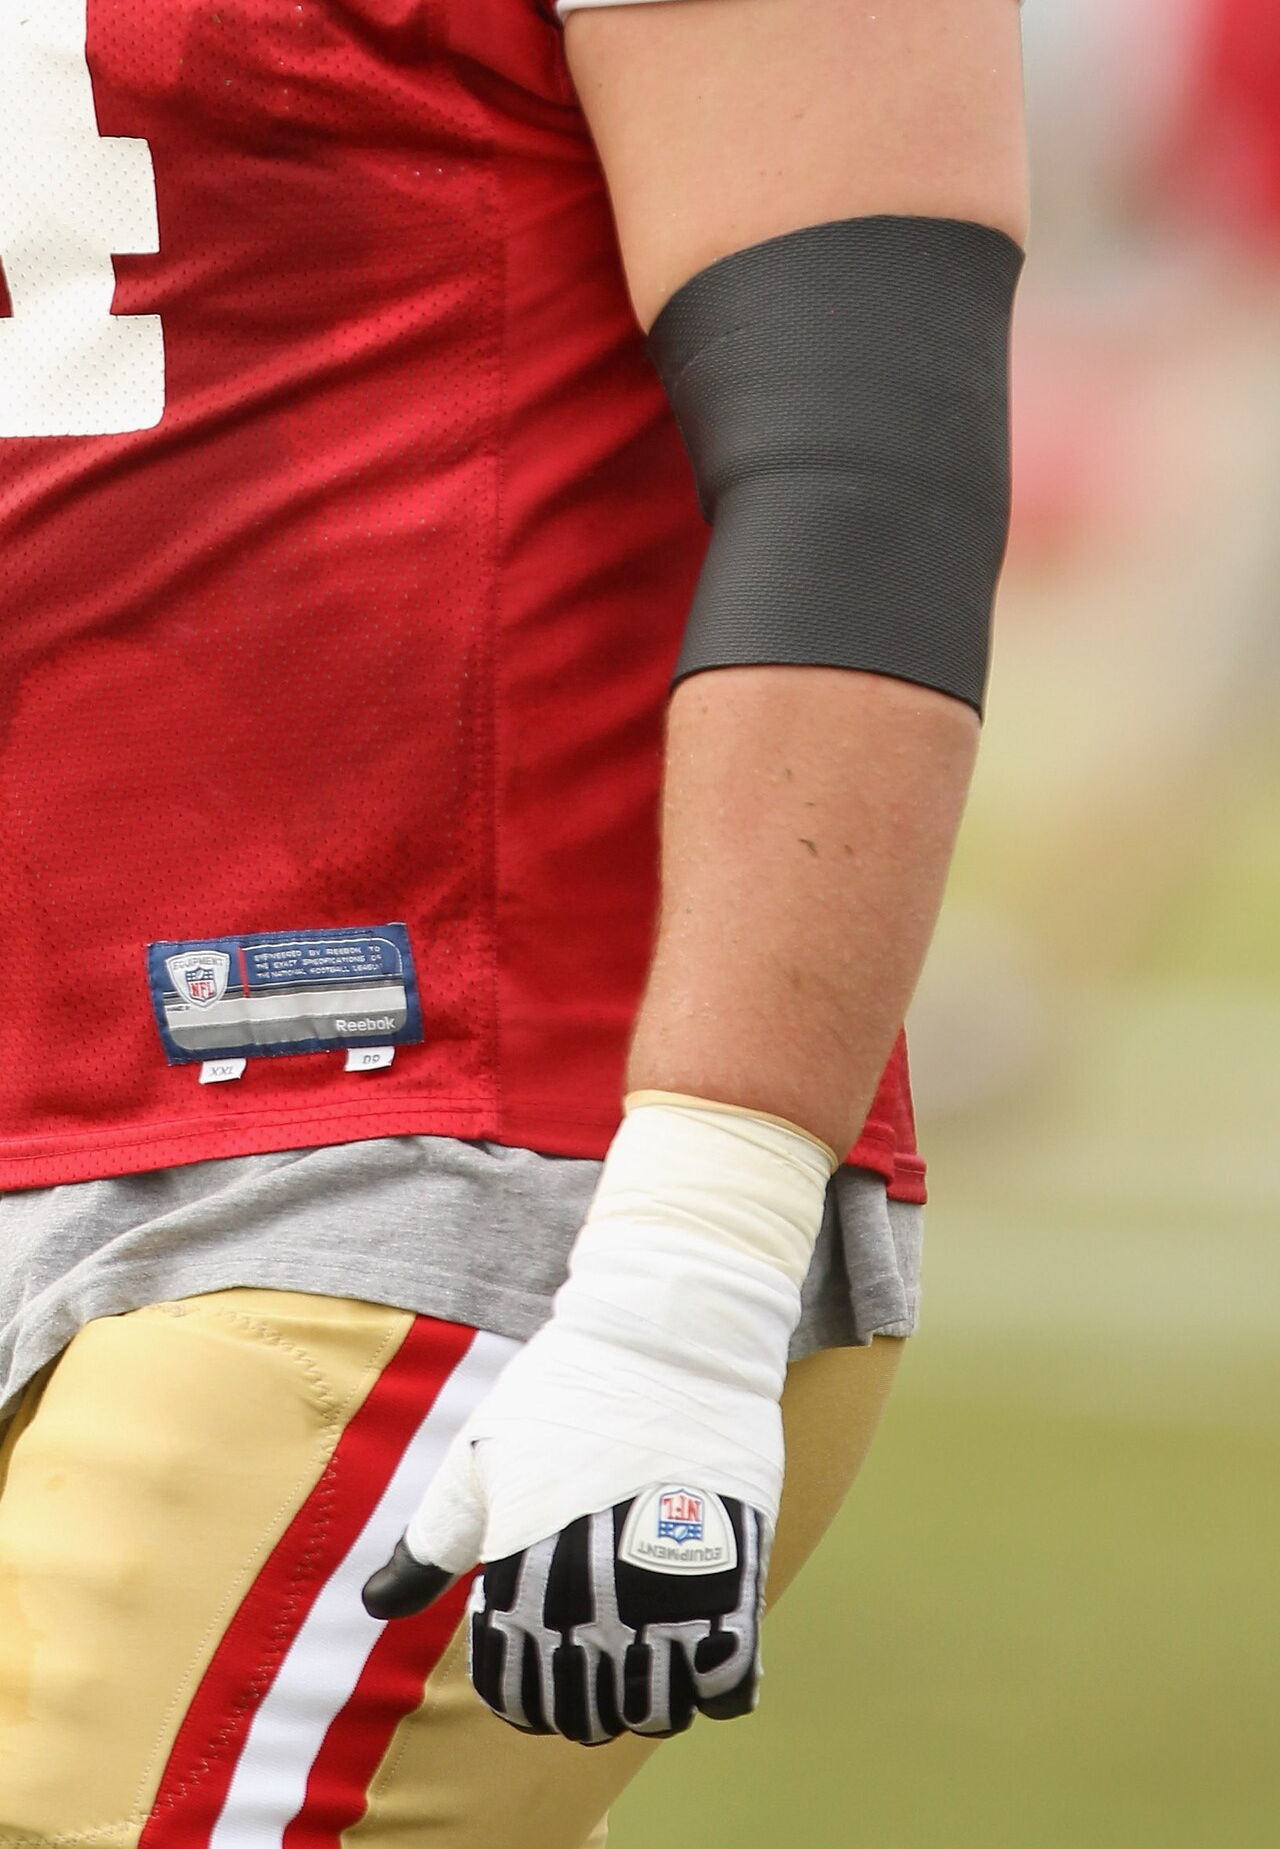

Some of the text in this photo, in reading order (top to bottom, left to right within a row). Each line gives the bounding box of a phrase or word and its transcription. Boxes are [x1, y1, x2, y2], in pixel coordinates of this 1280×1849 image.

[190, 981, 215, 999] NFL
[335, 1016, 396, 1032] Reebok
[662, 1494, 701, 1521] NFL
[638, 1541, 723, 1561] EQUIPMENT
